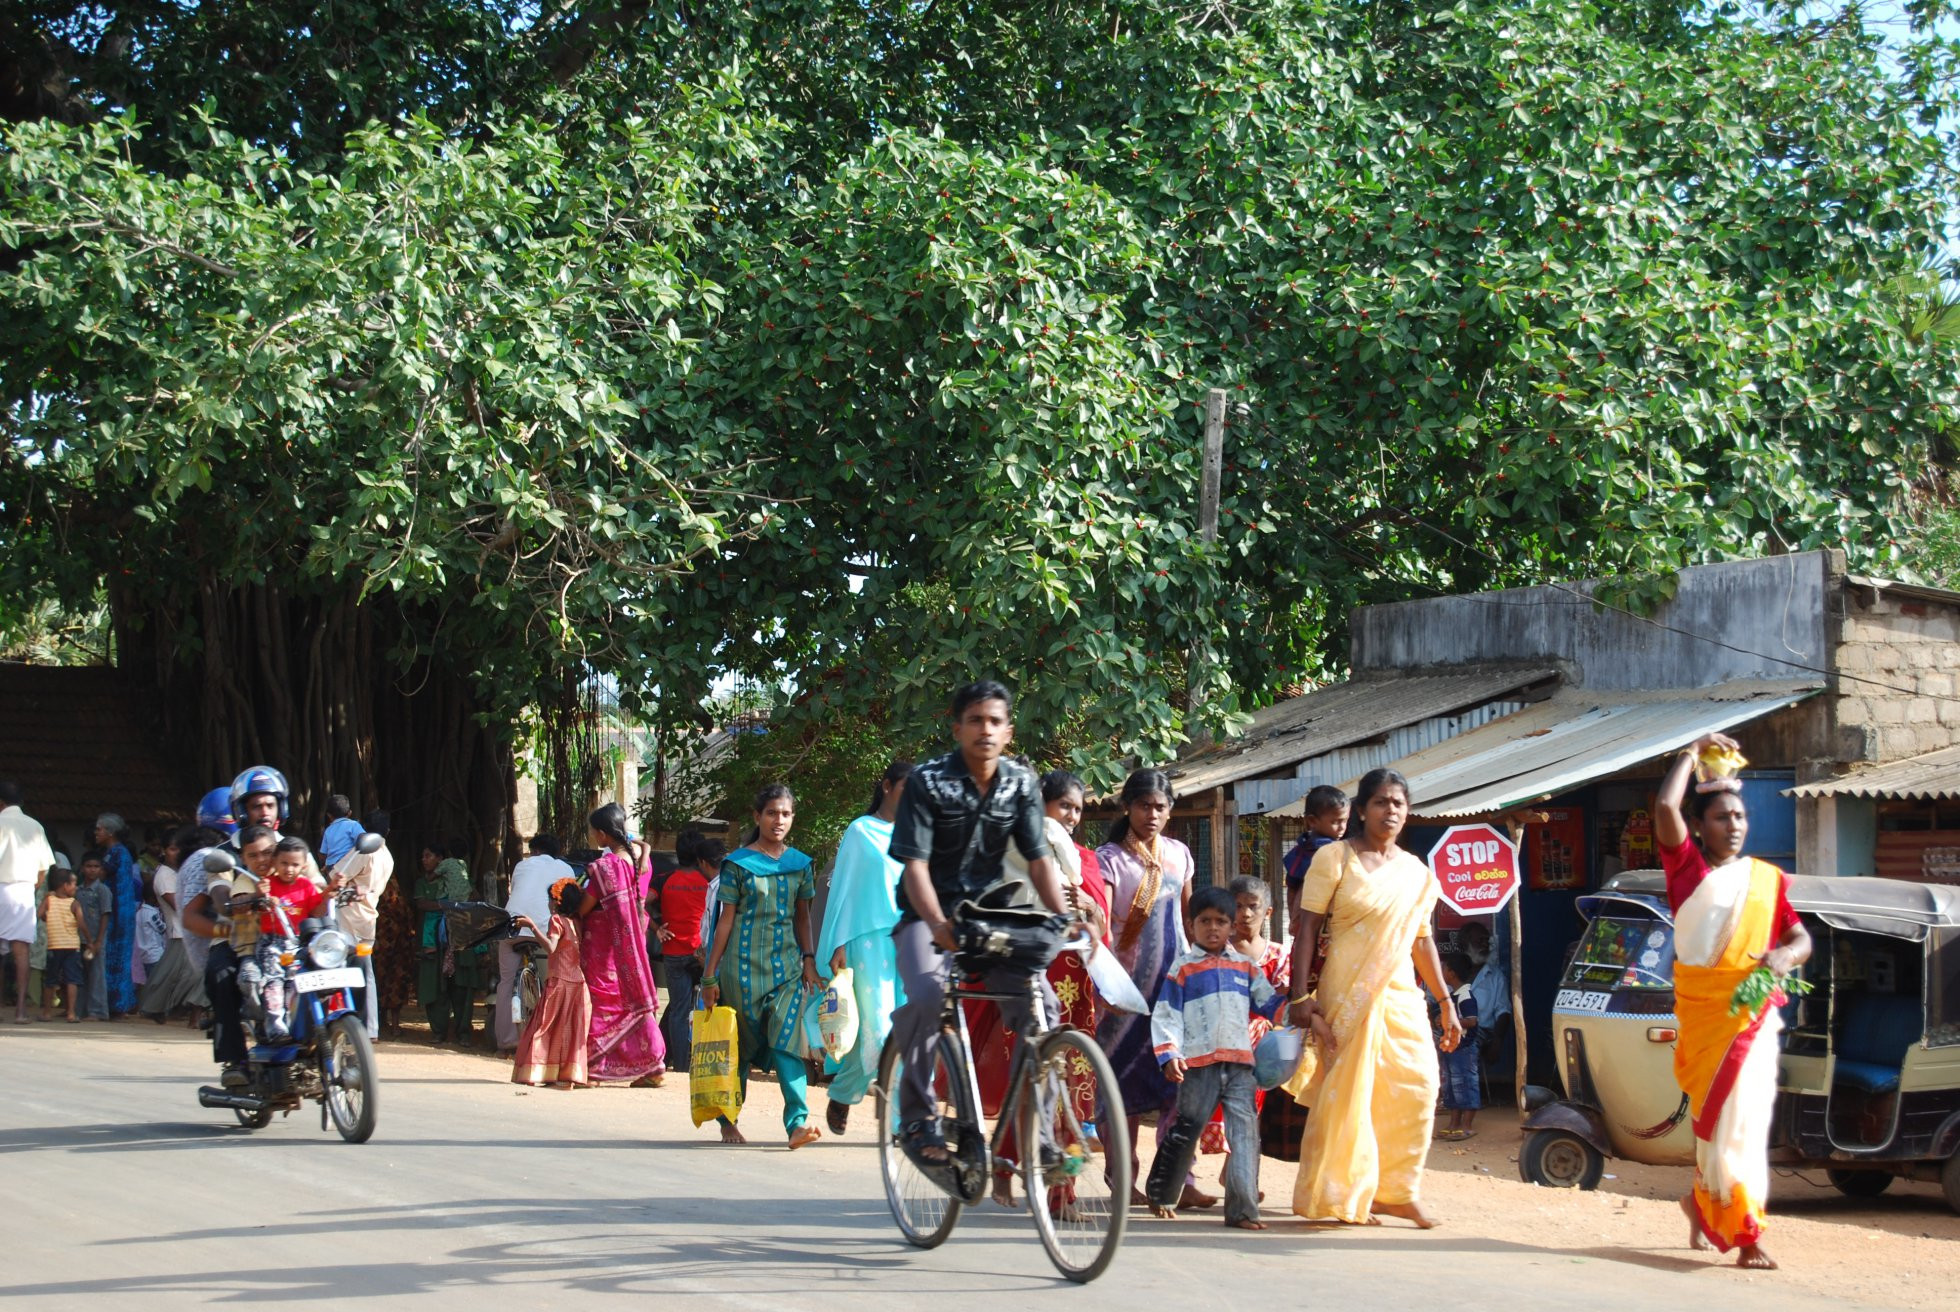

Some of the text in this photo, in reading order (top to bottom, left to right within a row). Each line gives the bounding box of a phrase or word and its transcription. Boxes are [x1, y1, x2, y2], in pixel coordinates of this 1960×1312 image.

[1446, 840, 1500, 867] STOP
[1447, 871, 1472, 883] Cool
[1455, 883, 1501, 902] Coca-Cola
